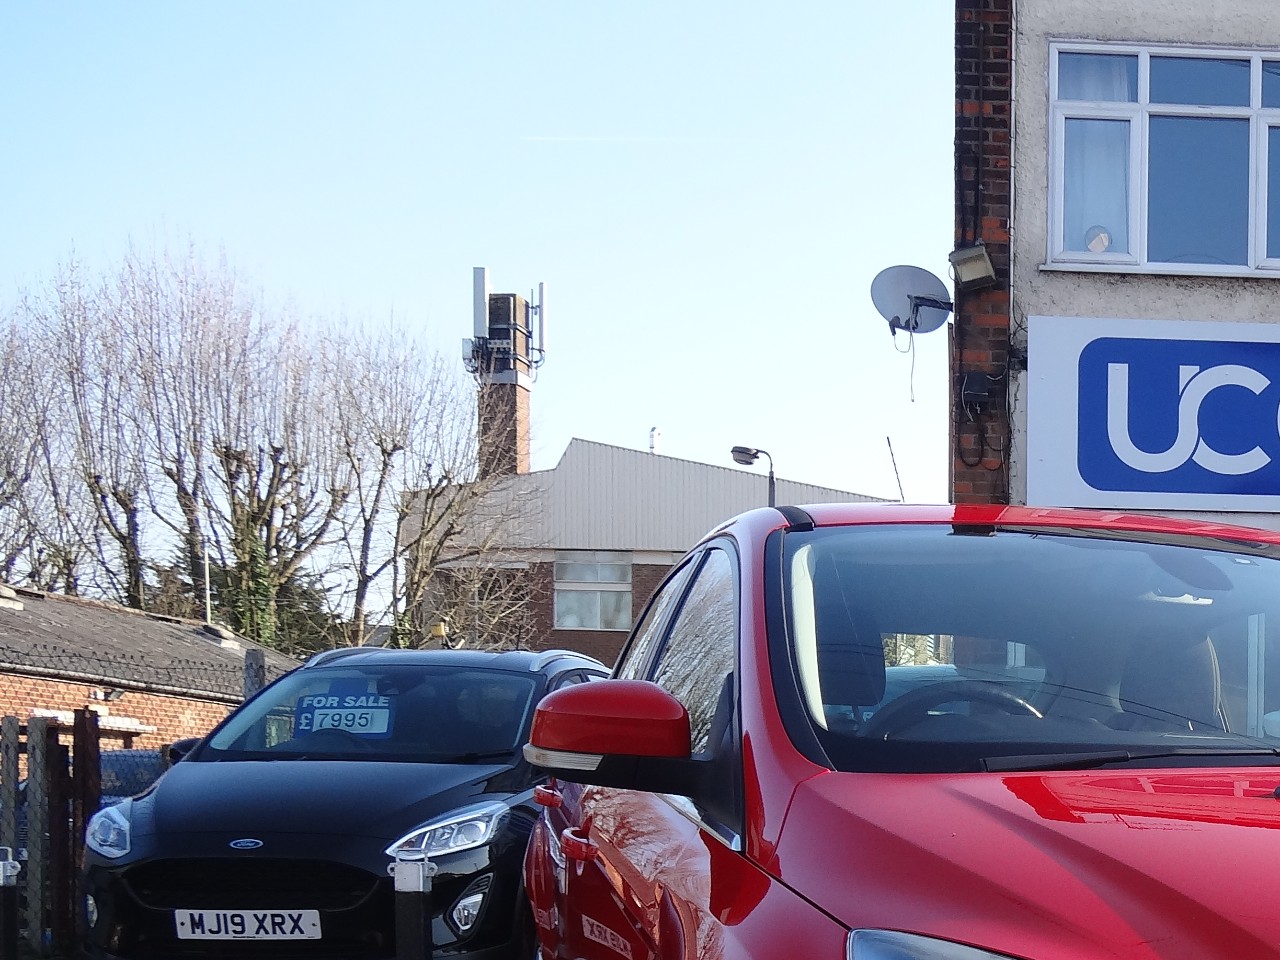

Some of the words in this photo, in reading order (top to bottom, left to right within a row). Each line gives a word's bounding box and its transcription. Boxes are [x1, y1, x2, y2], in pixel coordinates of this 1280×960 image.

[302, 696, 340, 708] FOR
[343, 695, 391, 707] SALE
[189, 912, 246, 935] MJ19
[252, 913, 305, 935] XRX
